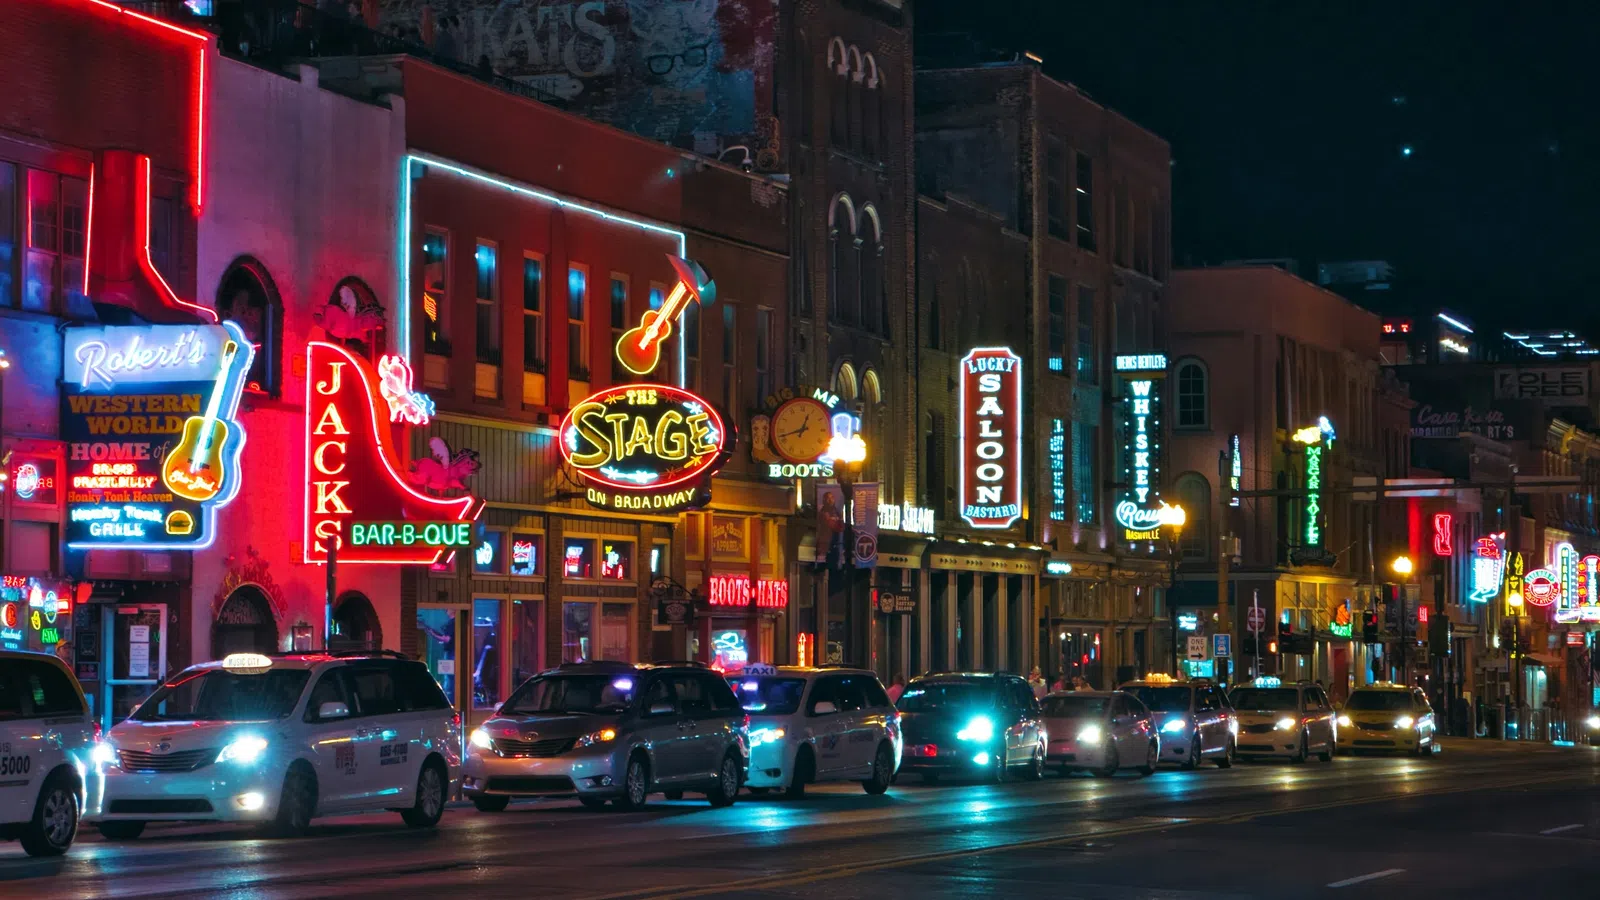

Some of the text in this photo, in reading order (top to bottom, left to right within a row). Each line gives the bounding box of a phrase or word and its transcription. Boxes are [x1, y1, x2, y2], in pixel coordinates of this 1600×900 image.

[75, 331, 204, 389] Robert's
[966, 357, 1016, 374] LUCKY
[1518, 372, 1583, 385] OLE
[626, 389, 658, 405] THE
[1518, 385, 1584, 397] RED
[68, 394, 201, 413] WESTERN
[1417, 404, 1458, 425] Casa
[87, 416, 183, 434] WORLD
[570, 402, 717, 468] STAGE
[976, 374, 1004, 503] SALOON
[1131, 381, 1151, 502] WHISKEY
[71, 441, 170, 464] HOME of
[769, 463, 834, 478] BOOTS
[73, 476, 157, 488] BRAZILBILLY
[68, 491, 173, 504] Honky Tonk Heaven
[587, 488, 695, 509] ON BROADWAY
[966, 503, 1017, 519] BASTARD
[89, 522, 145, 537] GRILL
[352, 523, 470, 546] BAR-B-QUE
[1125, 528, 1160, 540] NASHVILLE
[1478, 538, 1496, 547] Tin
[709, 577, 788, 608] BOOTS HATS
[228, 657, 260, 666] MUSIC CITY
[743, 667, 774, 675] TAXI
[0, 756, 30, 775] 5000
